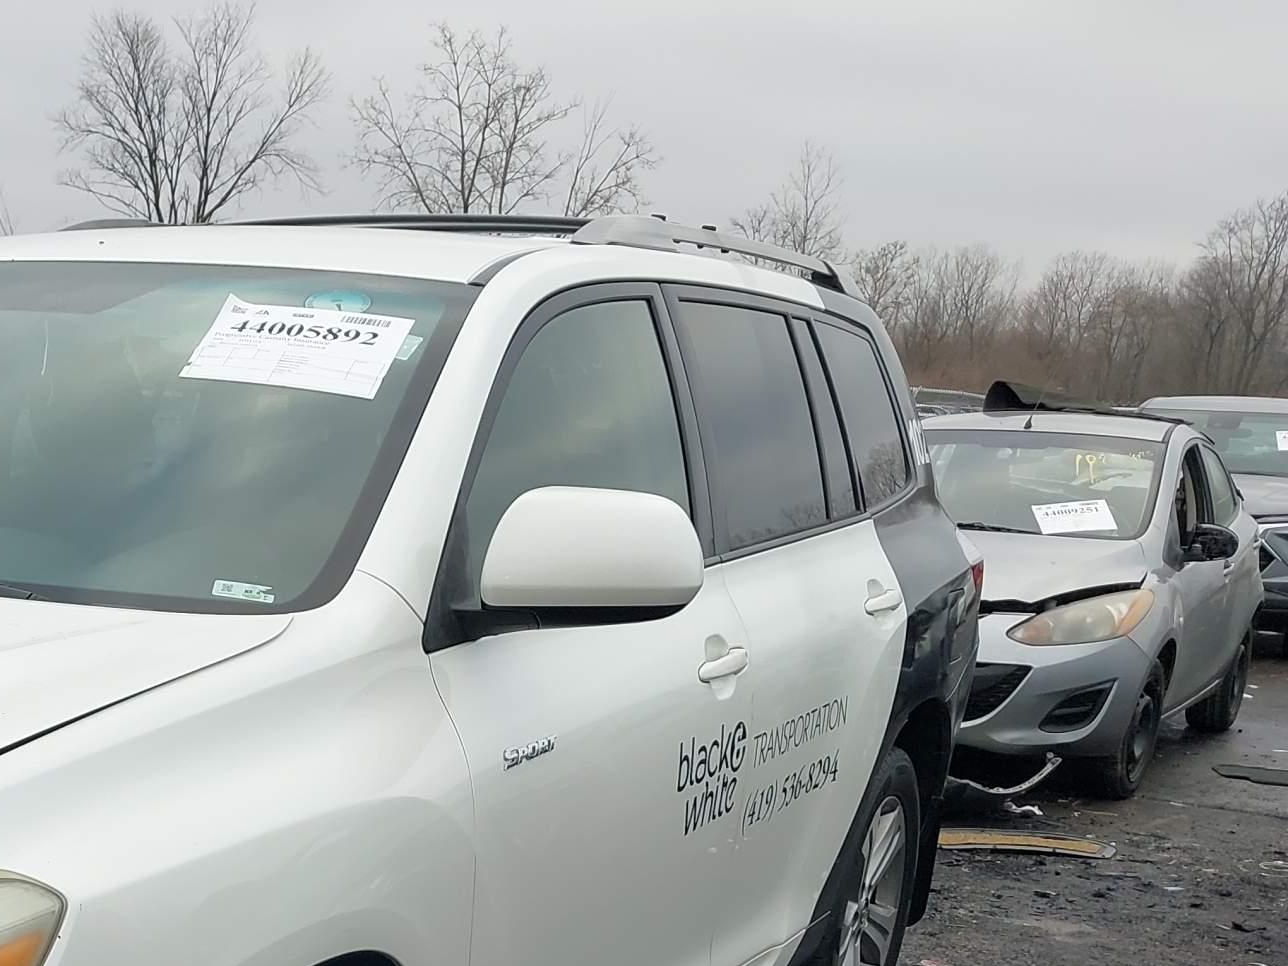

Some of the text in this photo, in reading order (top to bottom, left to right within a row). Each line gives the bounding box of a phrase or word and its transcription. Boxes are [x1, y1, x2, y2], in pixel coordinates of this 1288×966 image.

[230, 319, 380, 346] 44005892
[503, 735, 558, 771] SPORT
[753, 695, 849, 769] TRANSPORTATION
[684, 773, 737, 836] white
[742, 748, 840, 837] (419) 536-8294
